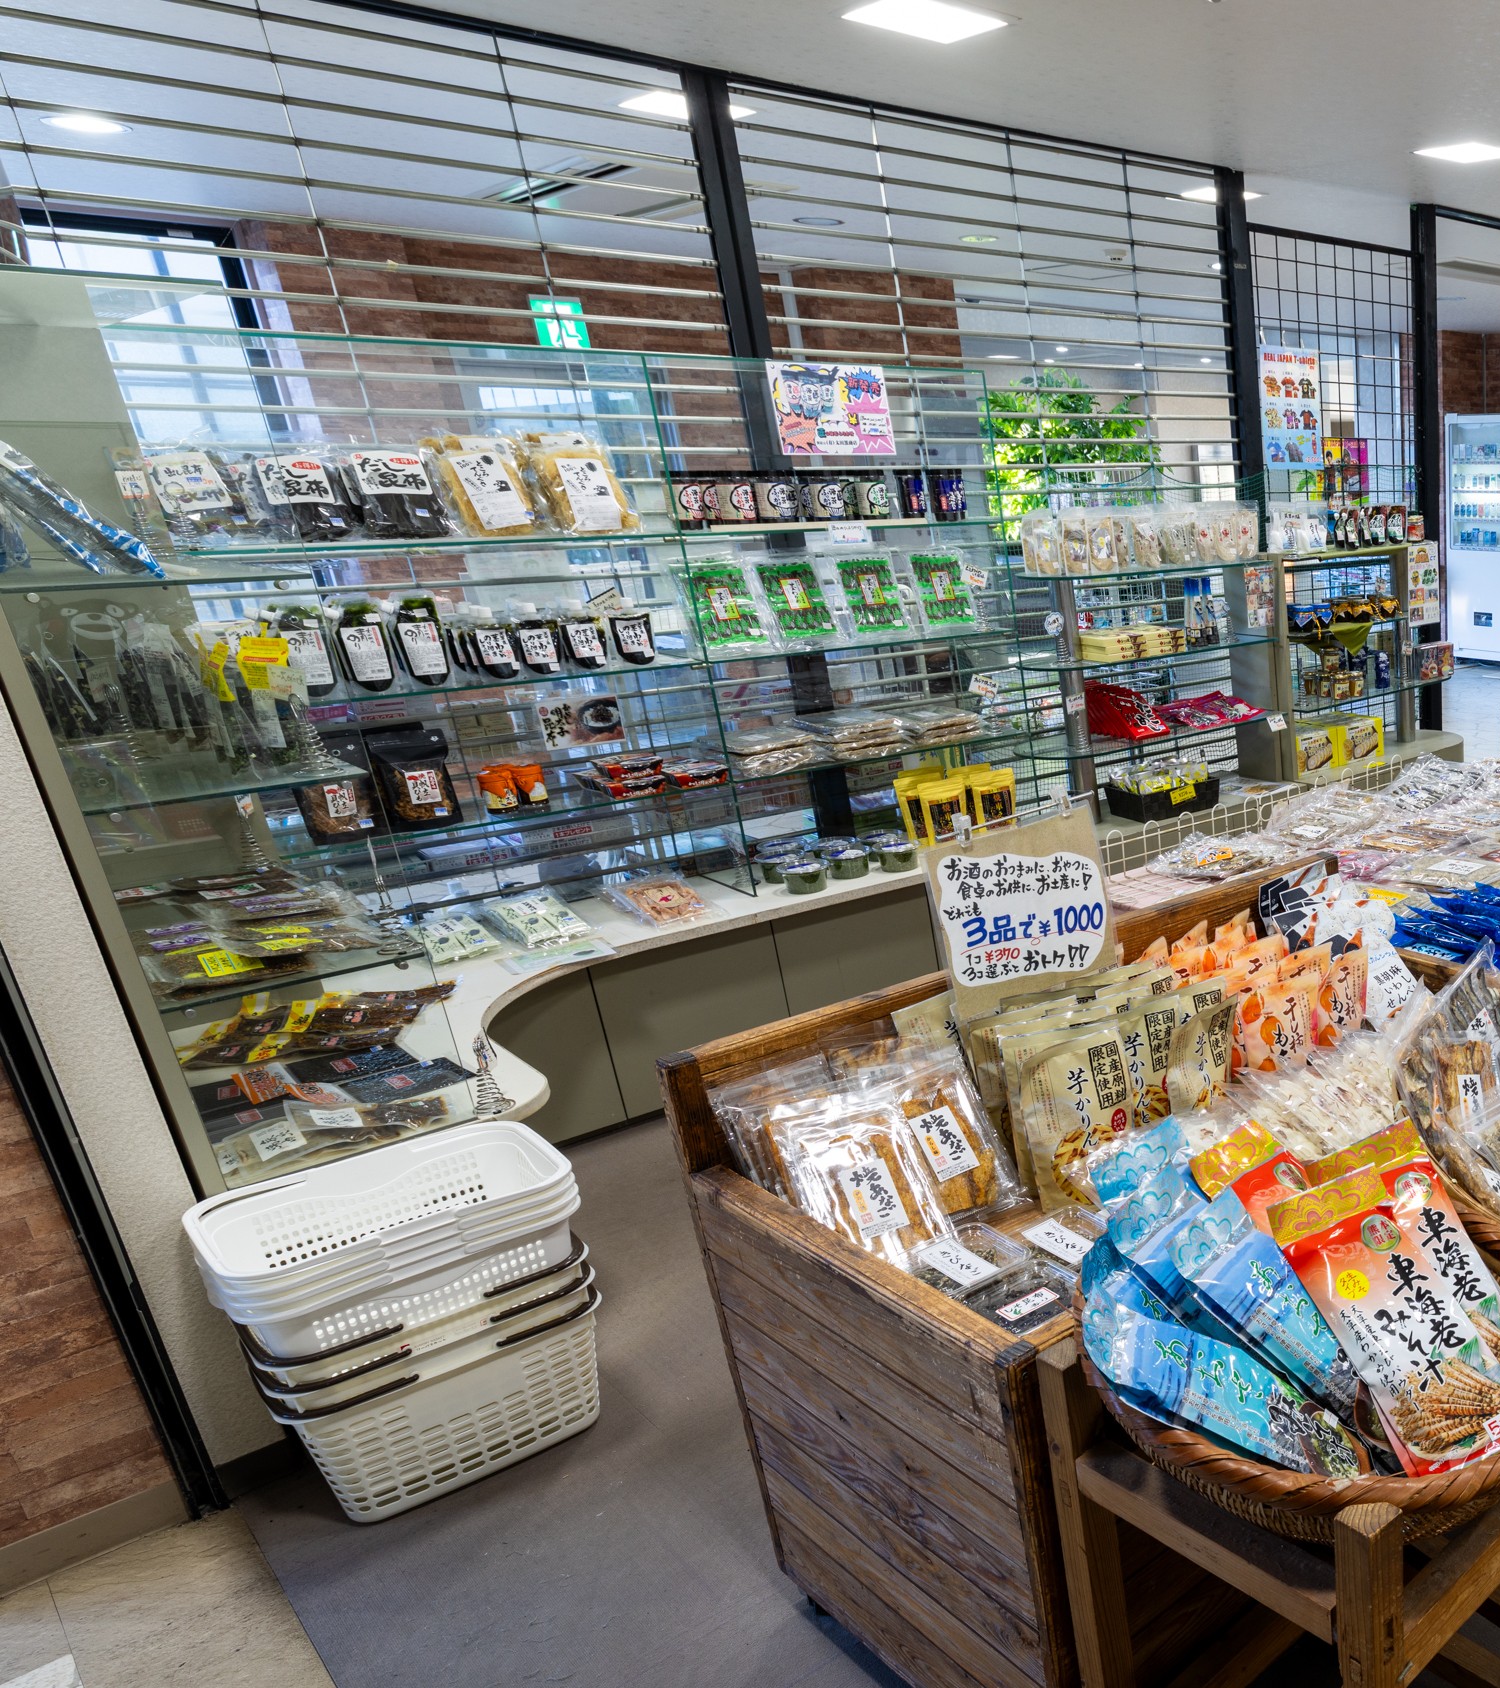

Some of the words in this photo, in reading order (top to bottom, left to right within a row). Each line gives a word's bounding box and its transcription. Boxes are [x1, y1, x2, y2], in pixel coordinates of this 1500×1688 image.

[847, 376, 881, 394] 新発売
[261, 464, 309, 482] だし
[285, 479, 329, 498] 昆布
[357, 457, 406, 473] だし
[378, 472, 427, 490] 昆布
[1337, 965, 1358, 1021] 干し柿
[1373, 965, 1402, 987] 黒胡麻
[1385, 975, 1412, 996] いわし
[1148, 1014, 1166, 1069] 限定使用
[1283, 996, 1304, 1054] 干し柿
[1091, 1047, 1114, 1106] 限定使用
[1104, 1042, 1126, 1100] 国産原料
[1066, 1067, 1098, 1149] 芋かりん
[919, 1114, 966, 1161] 焼あなご
[849, 1166, 897, 1218] 焼あなご
[1367, 1220, 1389, 1238] 熊本
[1373, 1231, 1395, 1247] 限定
[1419, 1206, 1487, 1303] 車海老
[1387, 1253, 1467, 1350] 車海老
[1373, 1308, 1446, 1394] みそ汁
